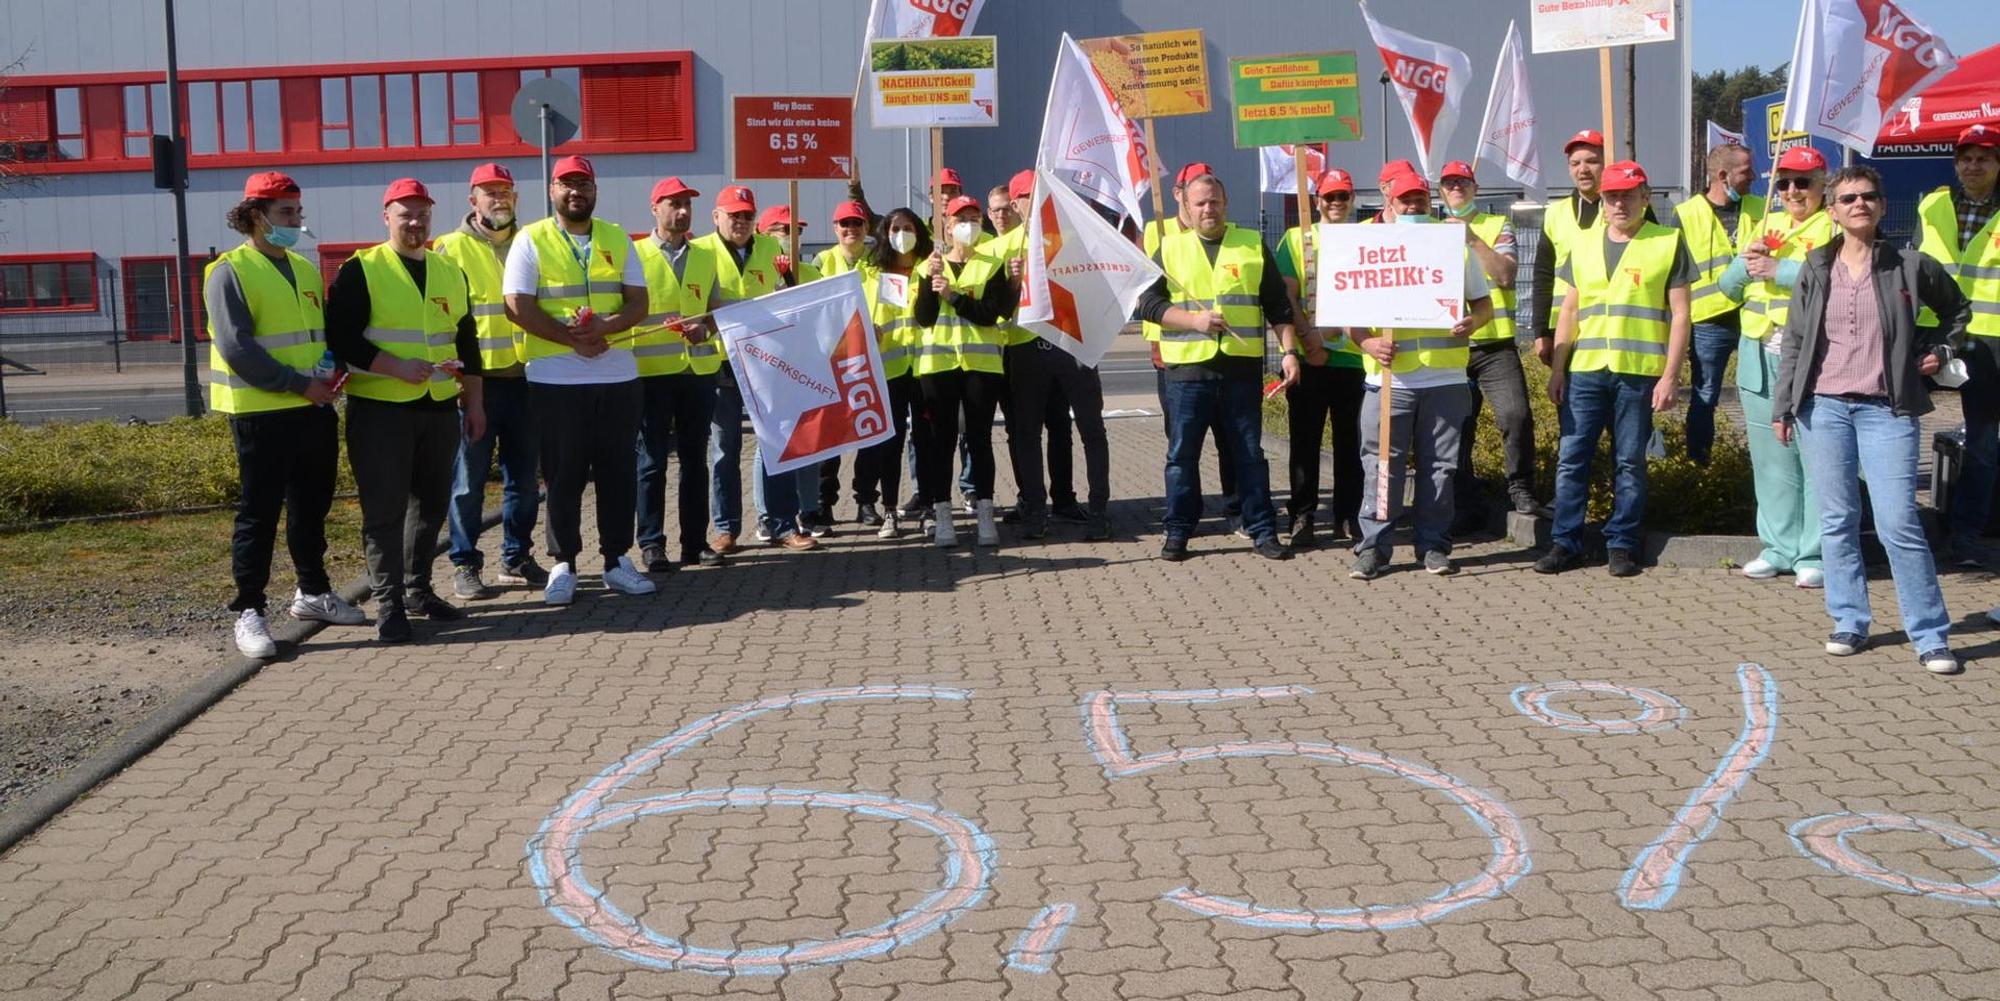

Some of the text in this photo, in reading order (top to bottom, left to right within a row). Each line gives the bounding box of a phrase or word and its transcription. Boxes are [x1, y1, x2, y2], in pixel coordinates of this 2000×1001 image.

[1538, 4, 1560, 13] Gute
[1872, 3, 1936, 69] NGG
[1130, 39, 1197, 52] So natürlich wie
[1130, 52, 1198, 65] unsere Produkte
[1138, 64, 1200, 77] muss auch die
[1244, 66, 1264, 75] Gute
[1394, 58, 1447, 94] NGG
[882, 76, 971, 89] NACHHALTIGkeit
[1121, 76, 1201, 91] Anerkennung sein!
[1296, 78, 1333, 88] kämpfen
[912, 93, 927, 103] bei
[930, 92, 949, 102] UNS
[952, 92, 968, 101] an!
[773, 101, 815, 112] Hey Boss:
[1244, 108, 1267, 118] Jetzt
[1269, 106, 1287, 117] 6,5
[1300, 104, 1331, 115] mehr!
[1932, 109, 1981, 122] GEWERKSCHAFT
[746, 118, 840, 127] Sind wir dir etwa keine
[769, 133, 818, 151] 6,5 %
[781, 156, 799, 165] wert
[1358, 245, 1407, 265] Jetzt
[744, 343, 837, 400] GEWERKSCHAFT
[837, 354, 883, 438] NGG
